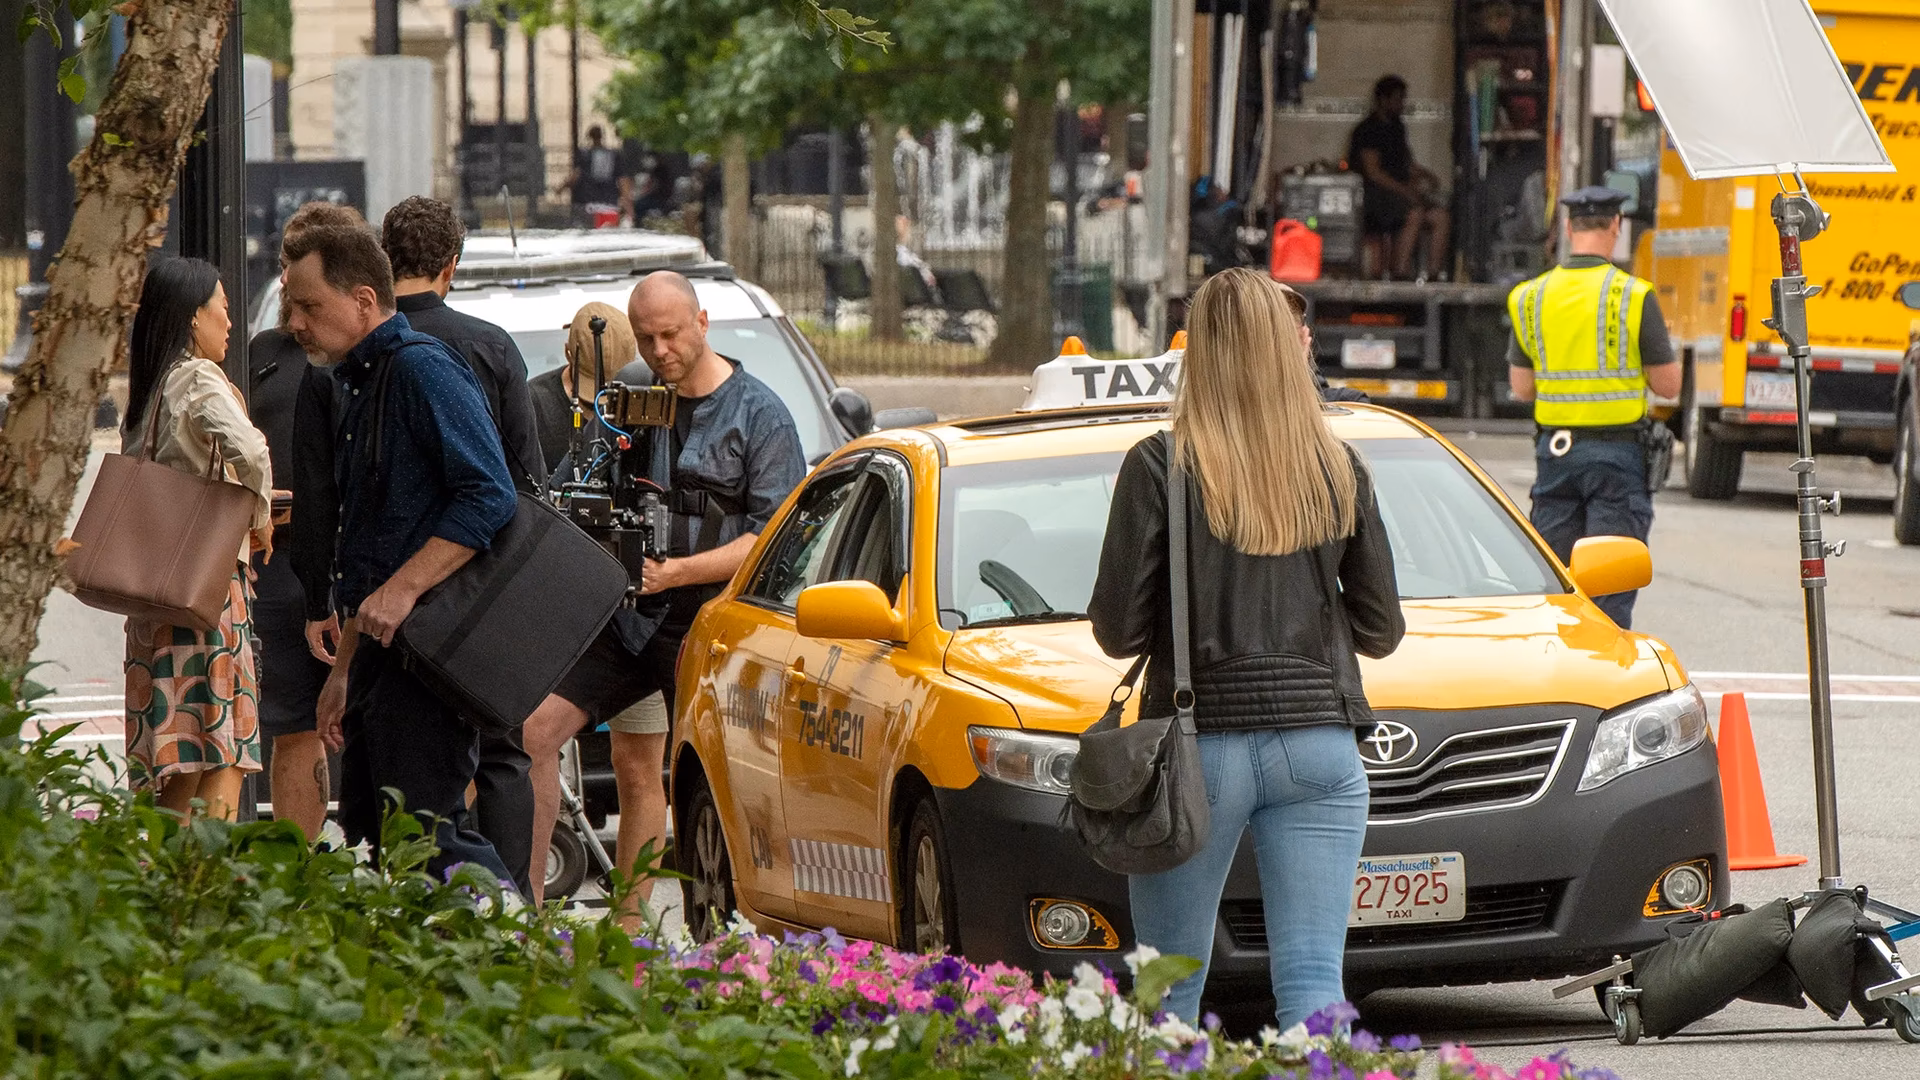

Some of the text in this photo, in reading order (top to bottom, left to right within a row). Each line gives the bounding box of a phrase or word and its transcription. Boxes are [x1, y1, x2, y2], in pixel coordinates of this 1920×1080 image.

[1901, 184, 1917, 202] &
[1072, 362, 1177, 399] TAX
[1361, 860, 1434, 873] Massachusetts
[1356, 871, 1448, 910] 27925
[1386, 909, 1412, 919] TAXI
